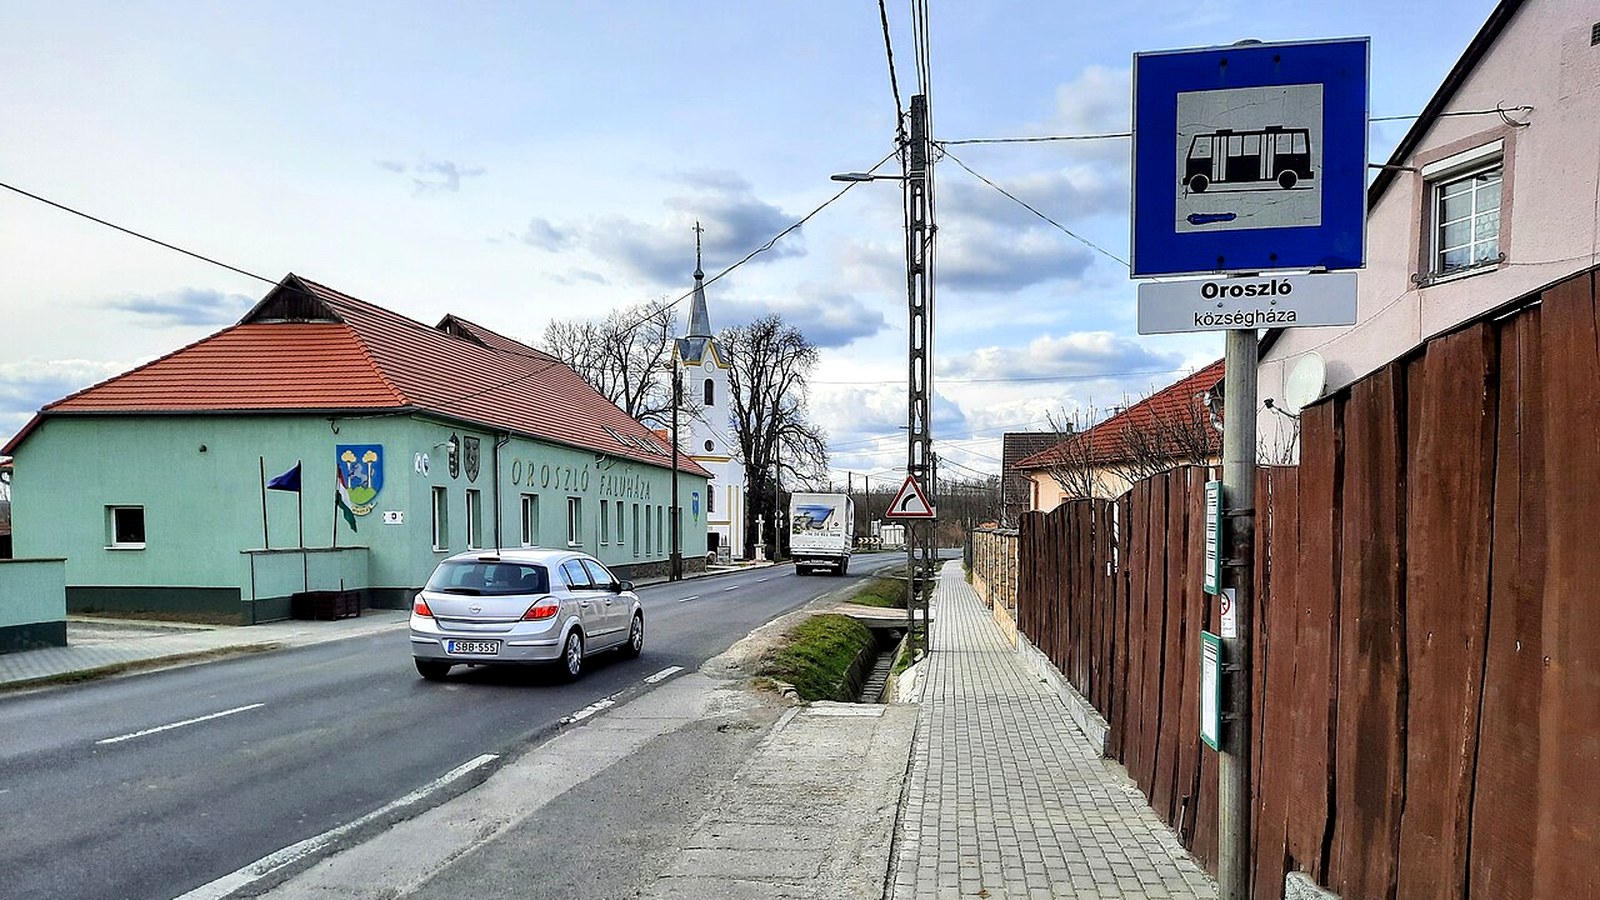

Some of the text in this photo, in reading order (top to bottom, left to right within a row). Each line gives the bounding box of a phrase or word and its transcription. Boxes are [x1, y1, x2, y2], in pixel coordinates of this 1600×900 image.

[1201, 278, 1292, 299] Oroszló
[1194, 308, 1297, 327] községháza
[511, 457, 651, 500] OROSZLÓ FALUHÁZA
